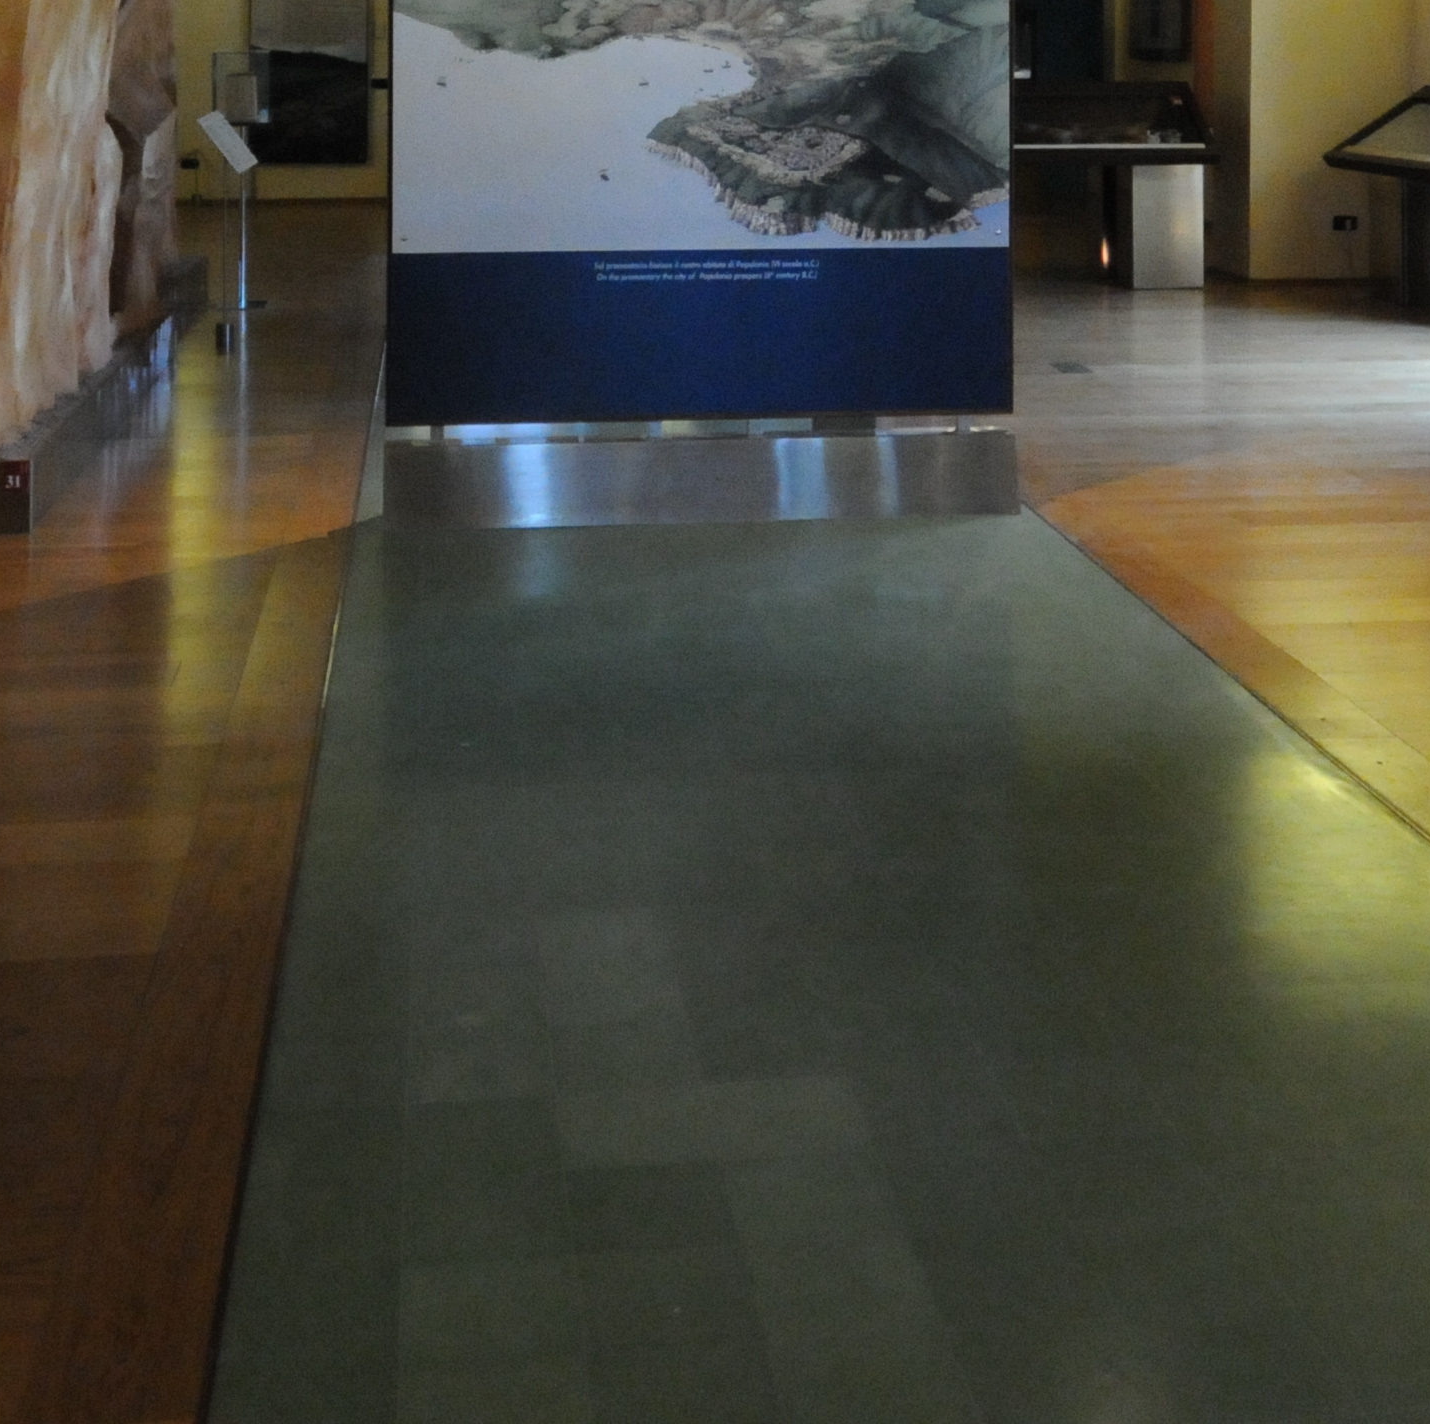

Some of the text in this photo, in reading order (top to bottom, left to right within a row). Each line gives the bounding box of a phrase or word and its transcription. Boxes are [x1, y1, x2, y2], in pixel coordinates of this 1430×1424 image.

[594, 261, 605, 270] Sul
[606, 261, 648, 272] promontorio
[736, 259, 770, 270] Populonia
[782, 259, 803, 268] secolo
[804, 258, 820, 268] a.C.)
[596, 273, 607, 281] On
[608, 272, 620, 281] the
[620, 273, 661, 283] promontory
[662, 271, 673, 280] the
[674, 272, 687, 283] city
[688, 271, 696, 280] of
[699, 271, 733, 282] Populonia
[775, 271, 801, 282] century
